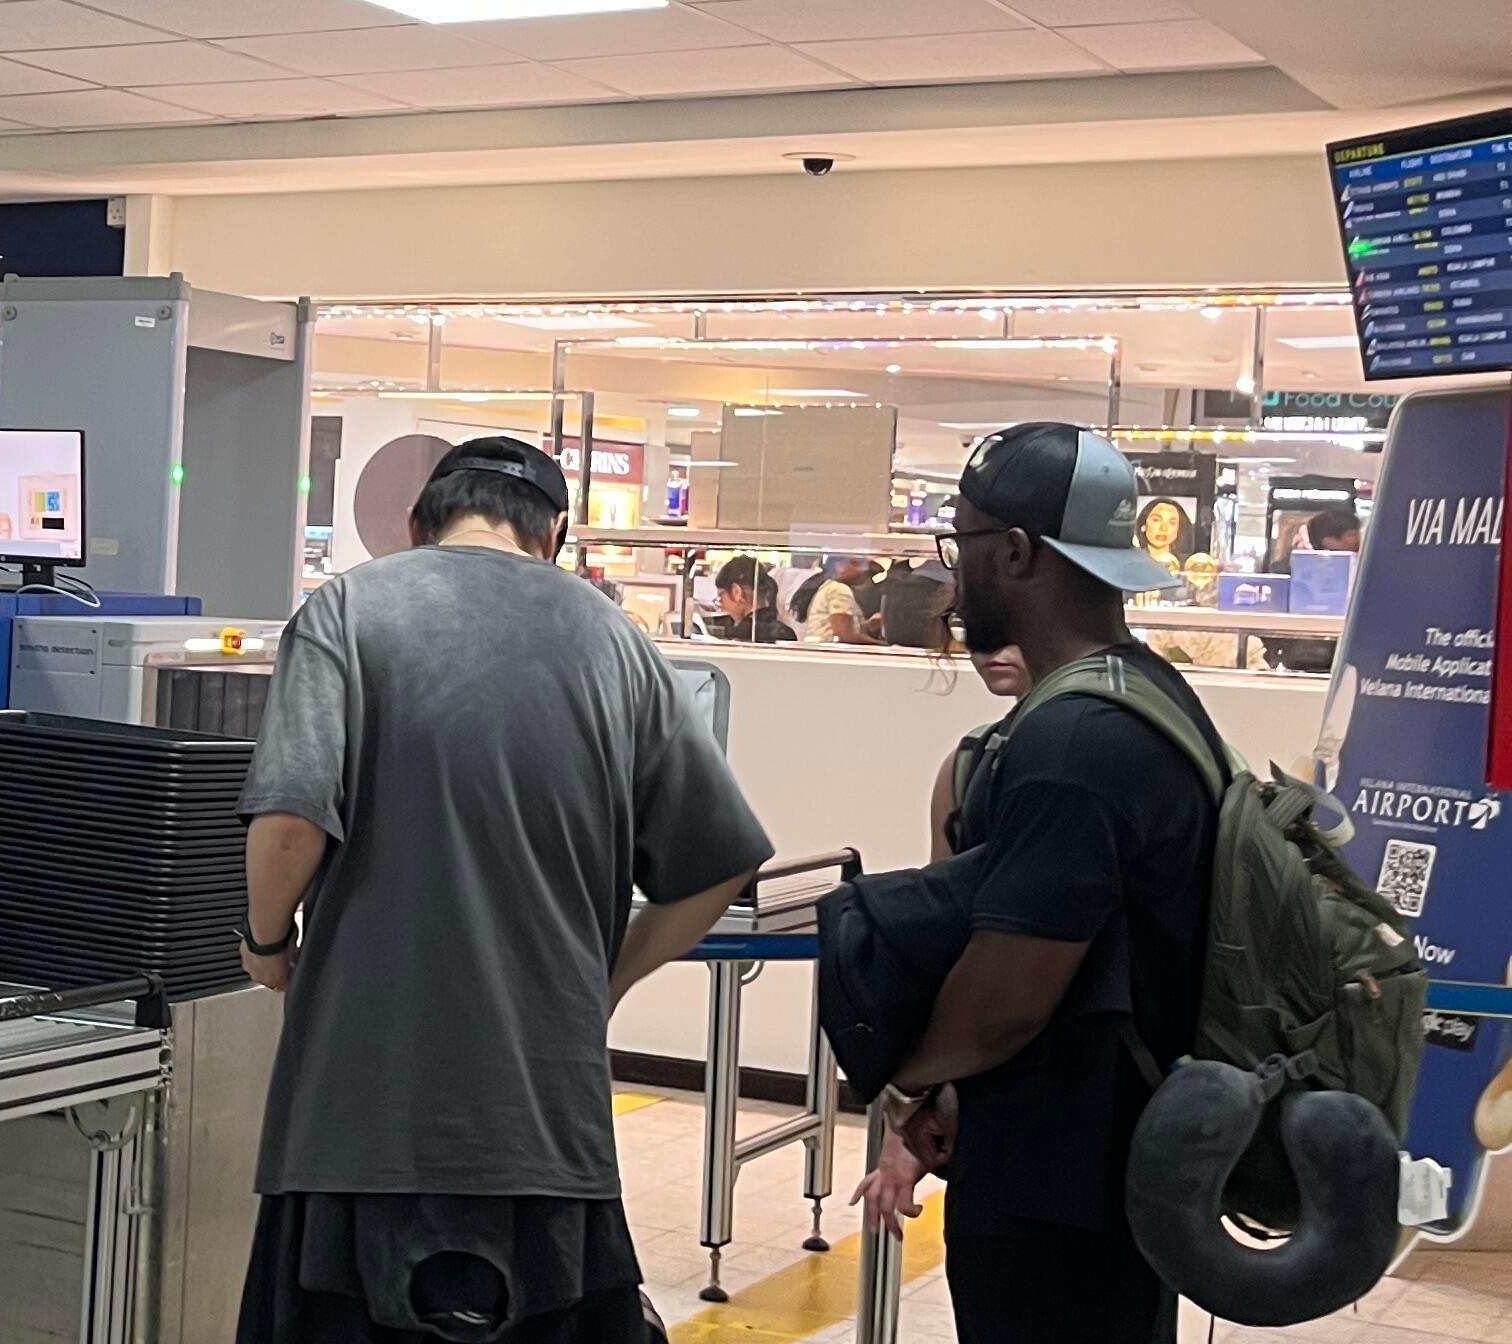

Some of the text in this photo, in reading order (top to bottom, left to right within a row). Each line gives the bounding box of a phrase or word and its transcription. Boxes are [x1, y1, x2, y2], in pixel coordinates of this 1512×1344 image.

[560, 447, 630, 475] CLRINS
[1405, 498, 1446, 545] VIA
[1425, 627, 1452, 646] The
[1385, 653, 1431, 672] Mobile
[1359, 677, 1402, 698] Velana
[1351, 788, 1469, 827] AIRPORT
